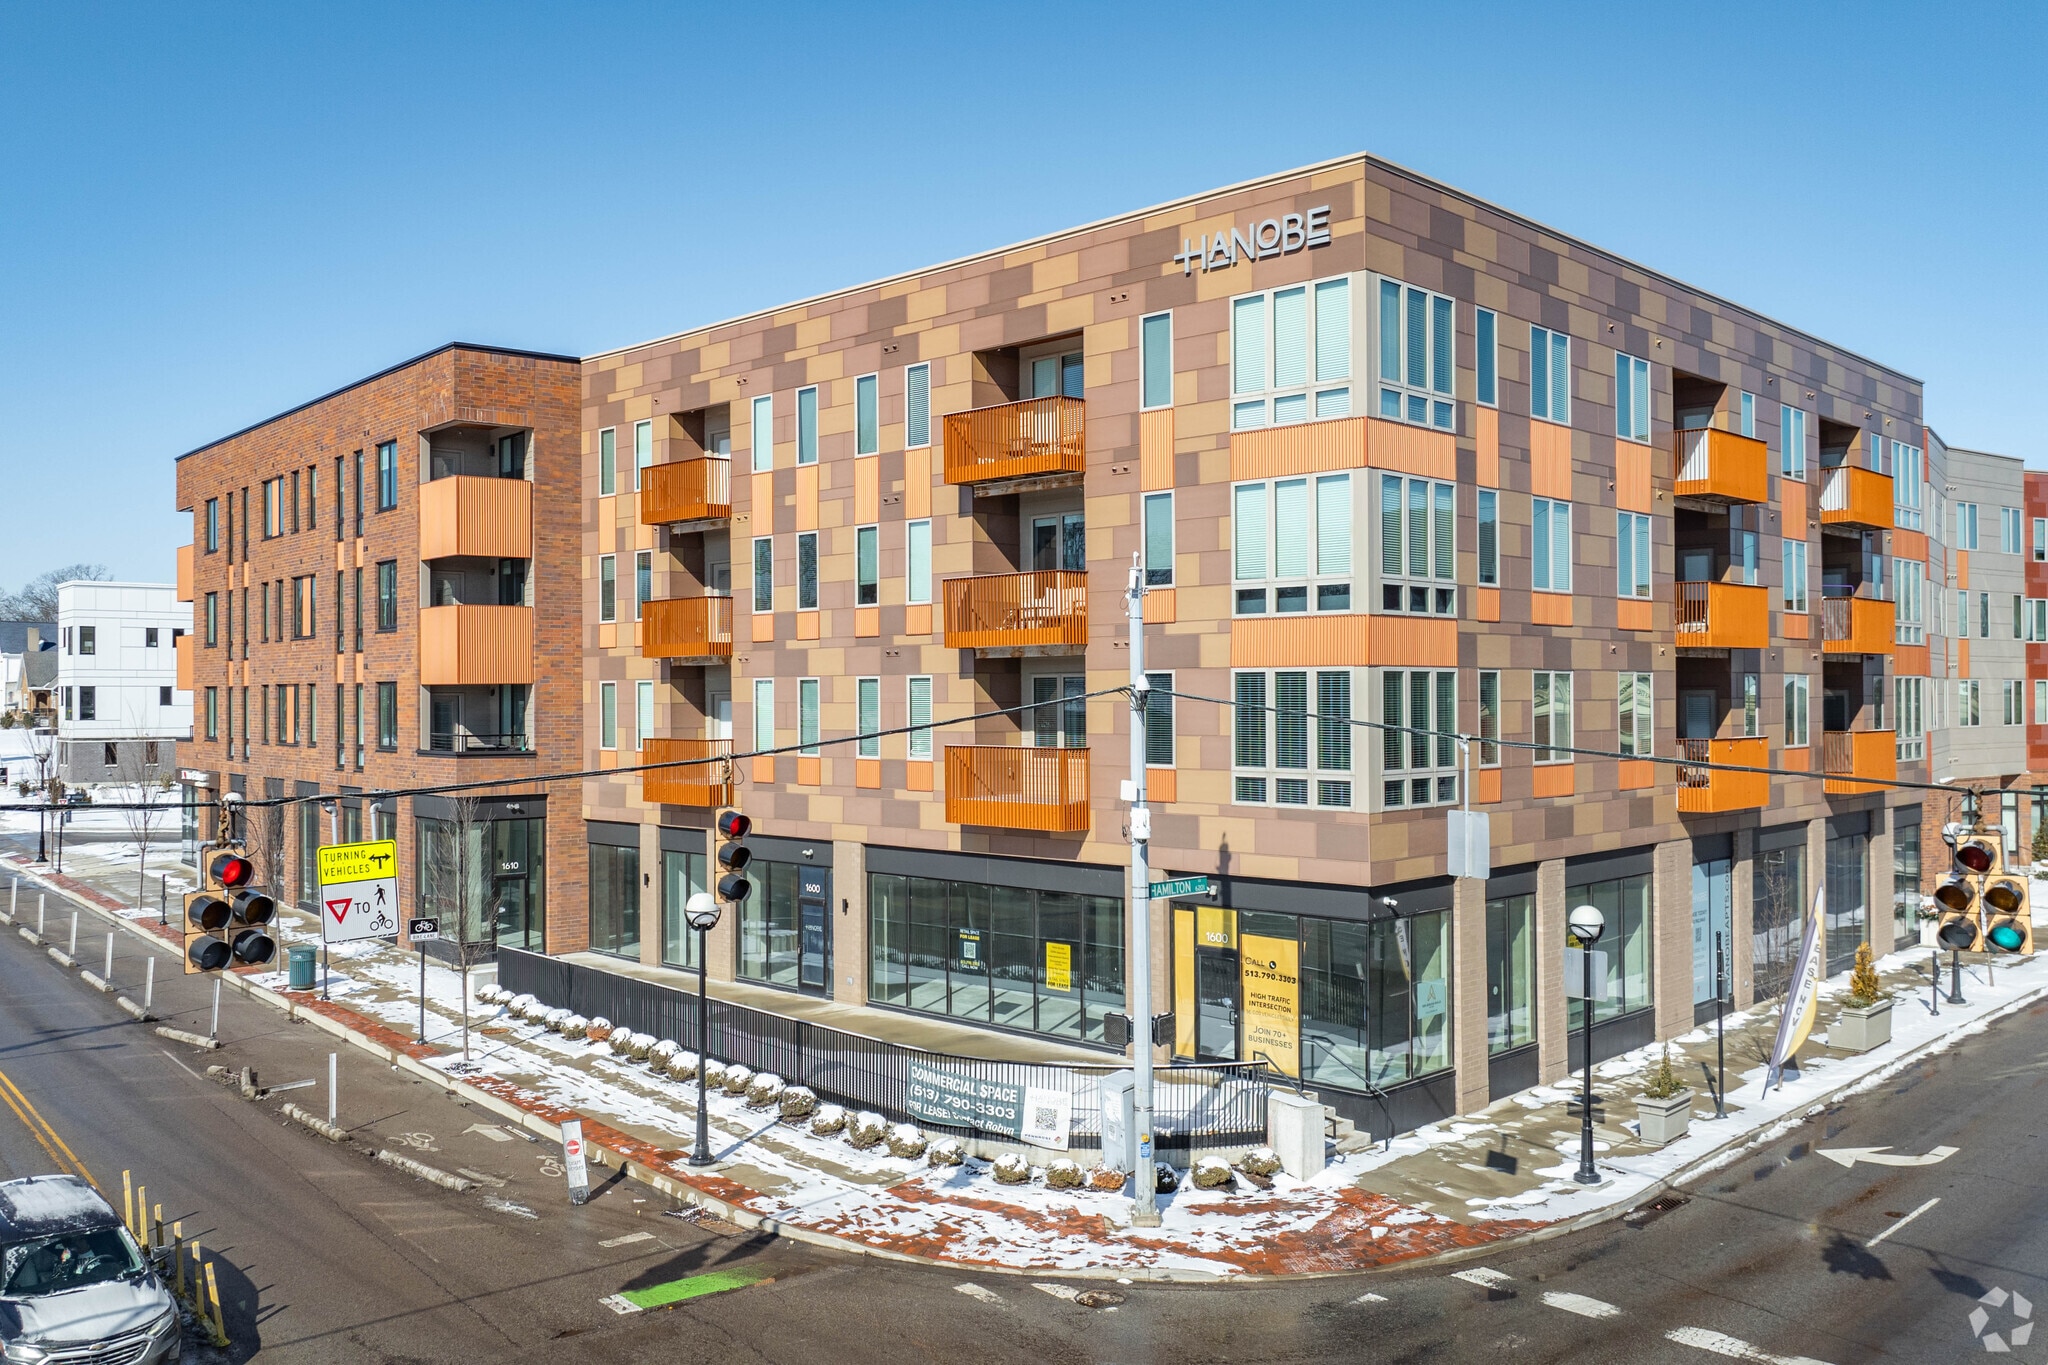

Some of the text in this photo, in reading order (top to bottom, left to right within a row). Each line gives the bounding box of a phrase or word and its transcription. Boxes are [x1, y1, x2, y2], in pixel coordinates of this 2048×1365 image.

[1174, 205, 1330, 274] HANOBE
[324, 850, 366, 862] TURNING
[323, 864, 370, 877] VEHICLES
[501, 862, 519, 870] 1610
[805, 883, 821, 893] 1600
[1151, 881, 1191, 896] HAMILTON
[354, 902, 370, 914] TO
[1206, 931, 1228, 944] 1600
[1245, 957, 1265, 967] CALL
[1804, 933, 1821, 989] EASE
[1245, 970, 1296, 984] 513.790.3303
[1251, 992, 1290, 1005] HIGH TRAFFIC
[1249, 1001, 1291, 1013] INTERSECTION
[1253, 1026, 1271, 1036] JOIN
[1248, 1035, 1293, 1049] BUSINESSES
[911, 1066, 1018, 1103] COMMERCIAL SPACE
[908, 1100, 922, 1113] FOR
[910, 1083, 1015, 1119] (513) 790-3303
